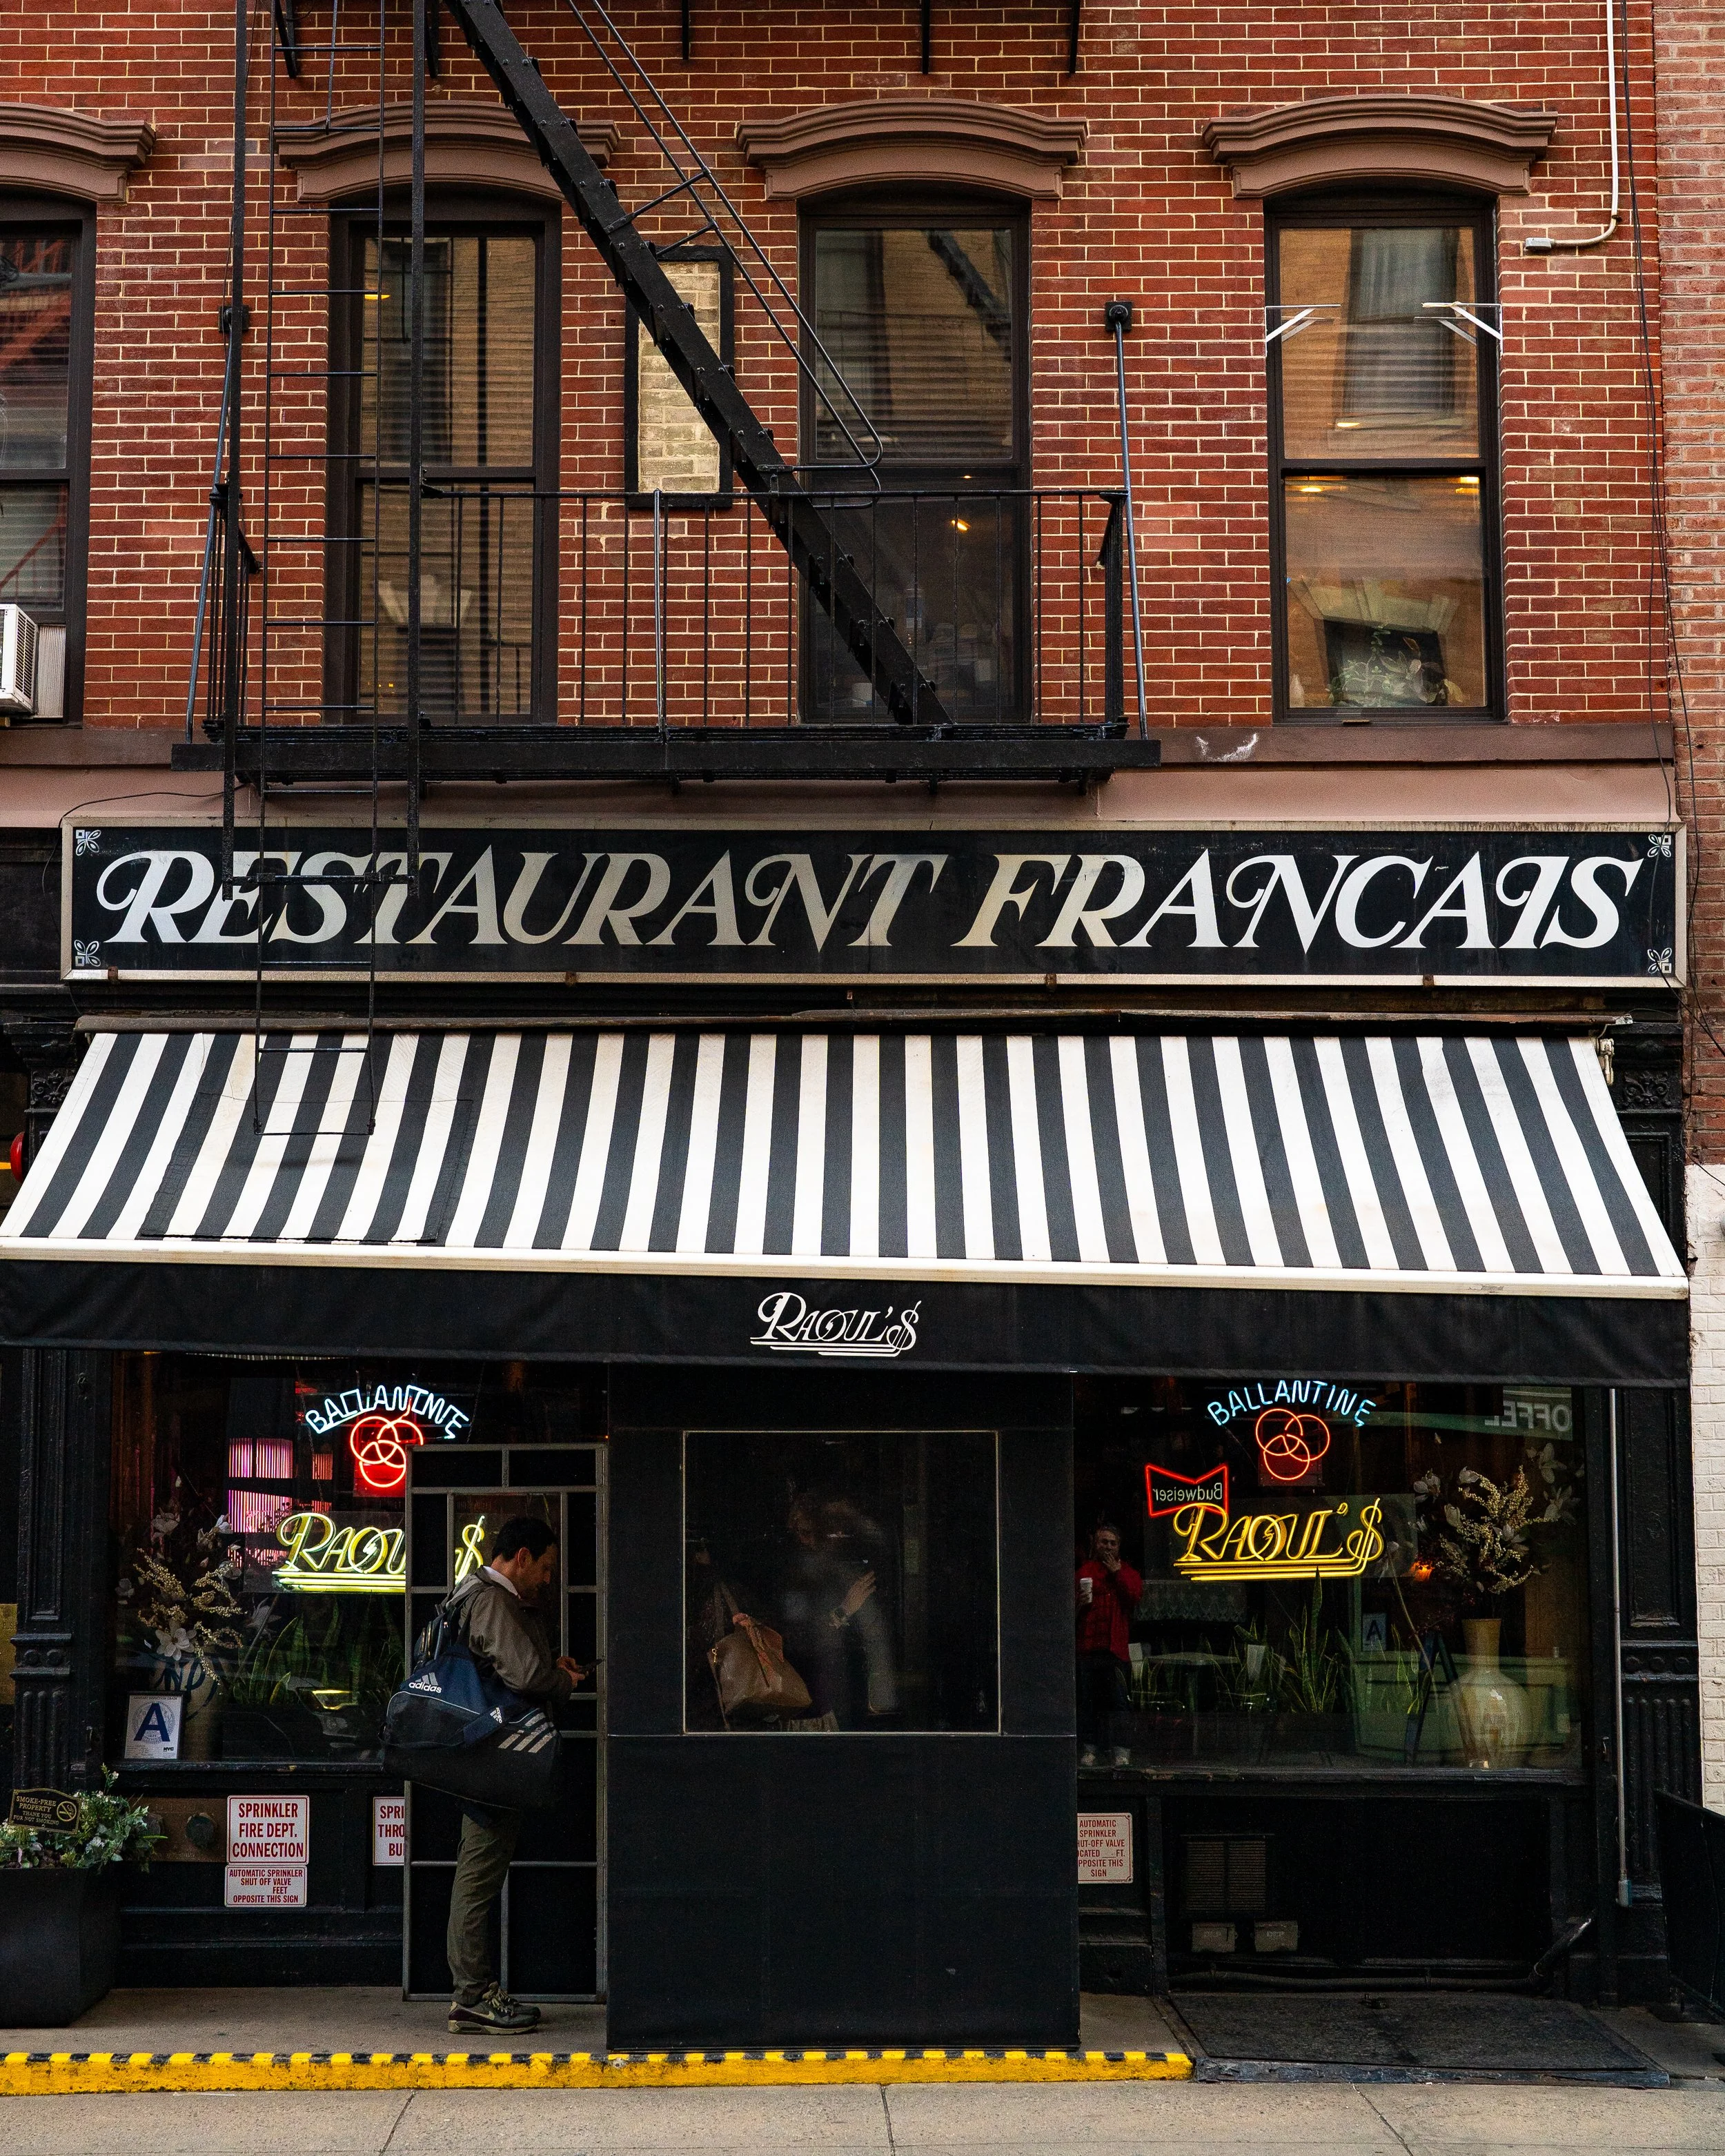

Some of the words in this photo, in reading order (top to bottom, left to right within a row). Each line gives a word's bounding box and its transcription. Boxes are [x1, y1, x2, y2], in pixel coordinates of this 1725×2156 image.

[95, 844, 948, 953] RESTAURANT
[951, 848, 1645, 955] FRANCAIS
[1207, 1380, 1377, 1427] BALLANTINE
[1366, 1619, 1382, 1641] A
[408, 1681, 442, 1694] adidas
[133, 1703, 170, 1742] A
[16, 1796, 57, 1806] SMOKE-FREE
[19, 1803, 51, 1812] PROPERTY
[238, 1803, 298, 1818] SPRINKLER
[36, 1817, 59, 1826] SMOKING
[239, 1823, 264, 1838] FIRE
[266, 1823, 297, 1838] DEPT.
[233, 1842, 304, 1857] CONNECTION
[1105, 1839, 1125, 1848] VALVE
[1116, 1849, 1125, 1857] FT.
[229, 1869, 266, 1877] AUTOMATIC
[267, 1869, 303, 1877] SPRINKLER
[233, 1895, 265, 1903] OPPOSITE
[266, 1895, 282, 1903] THIS
[283, 1895, 298, 1903] SIGN
